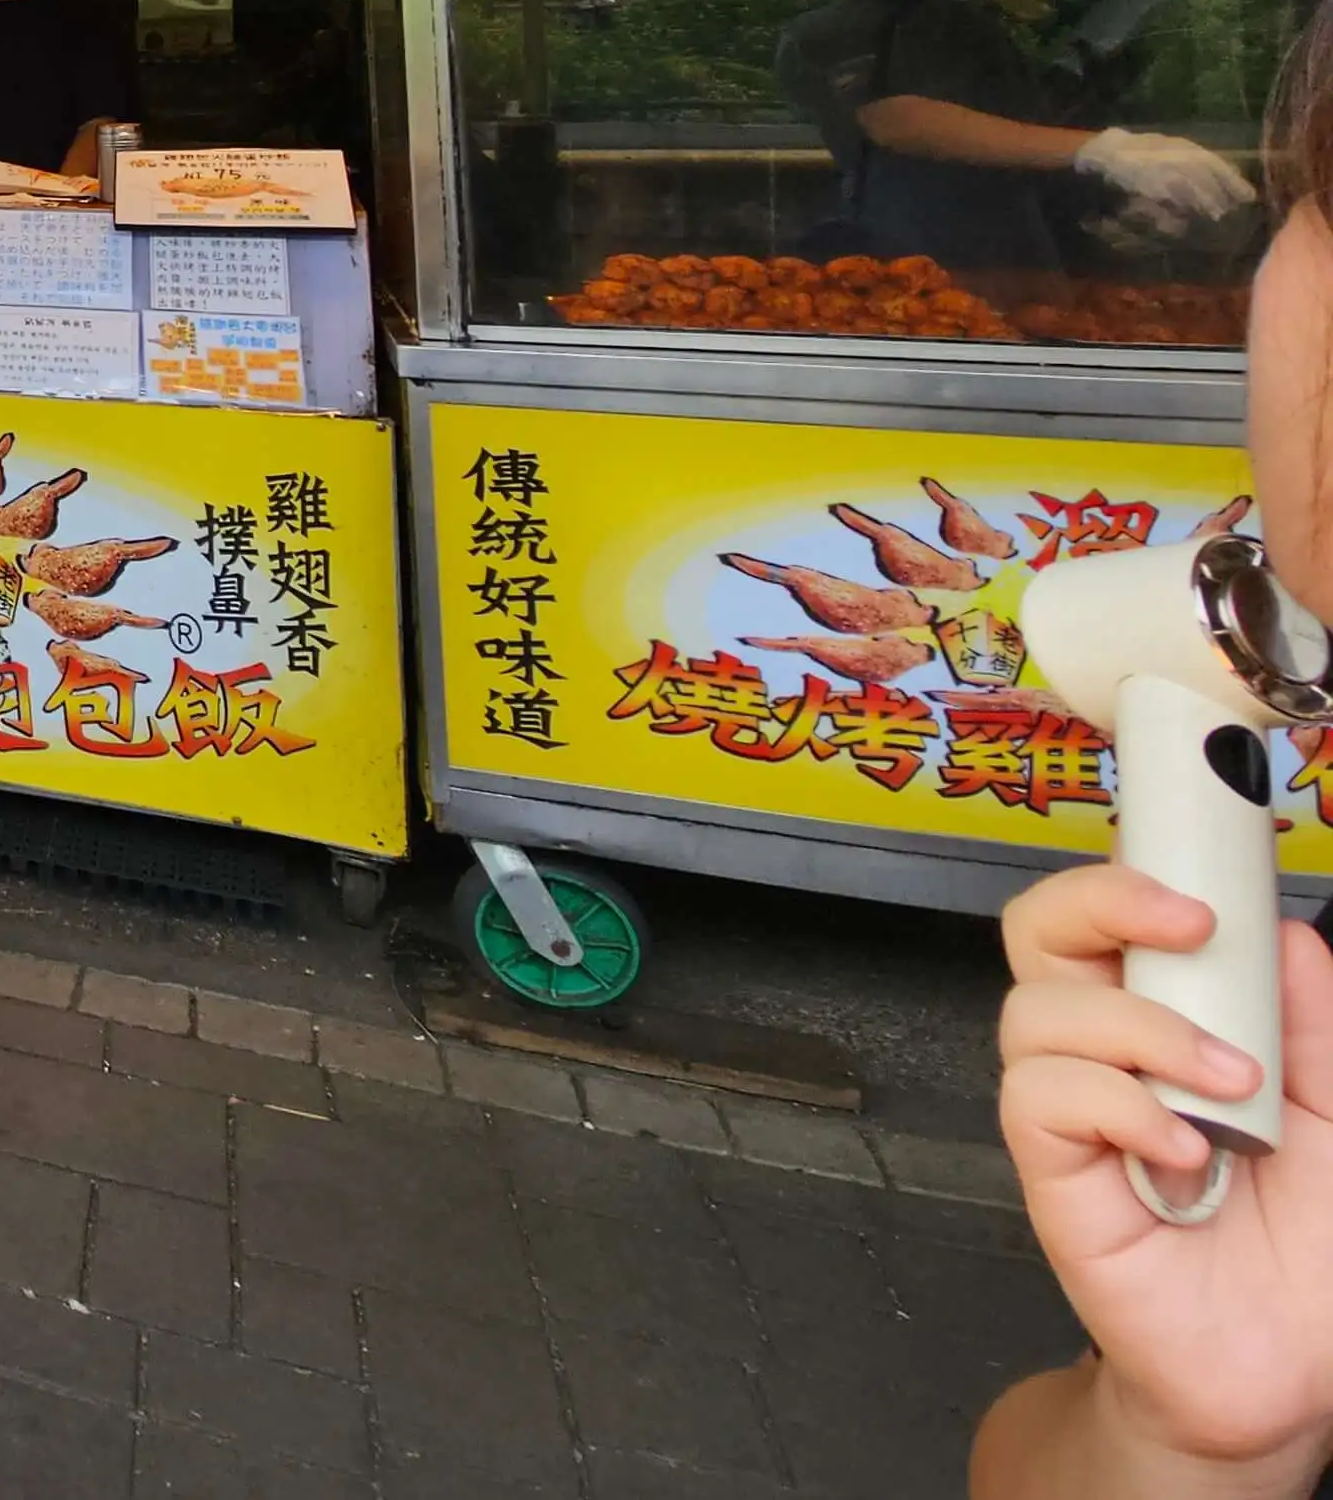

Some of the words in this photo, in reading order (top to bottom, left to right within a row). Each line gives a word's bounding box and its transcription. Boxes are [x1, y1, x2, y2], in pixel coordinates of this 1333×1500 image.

[213, 168, 243, 181] 75
[194, 503, 262, 638] 撲鼻
[264, 471, 339, 678] 雞翅香
[463, 446, 570, 752] 傳統好味道
